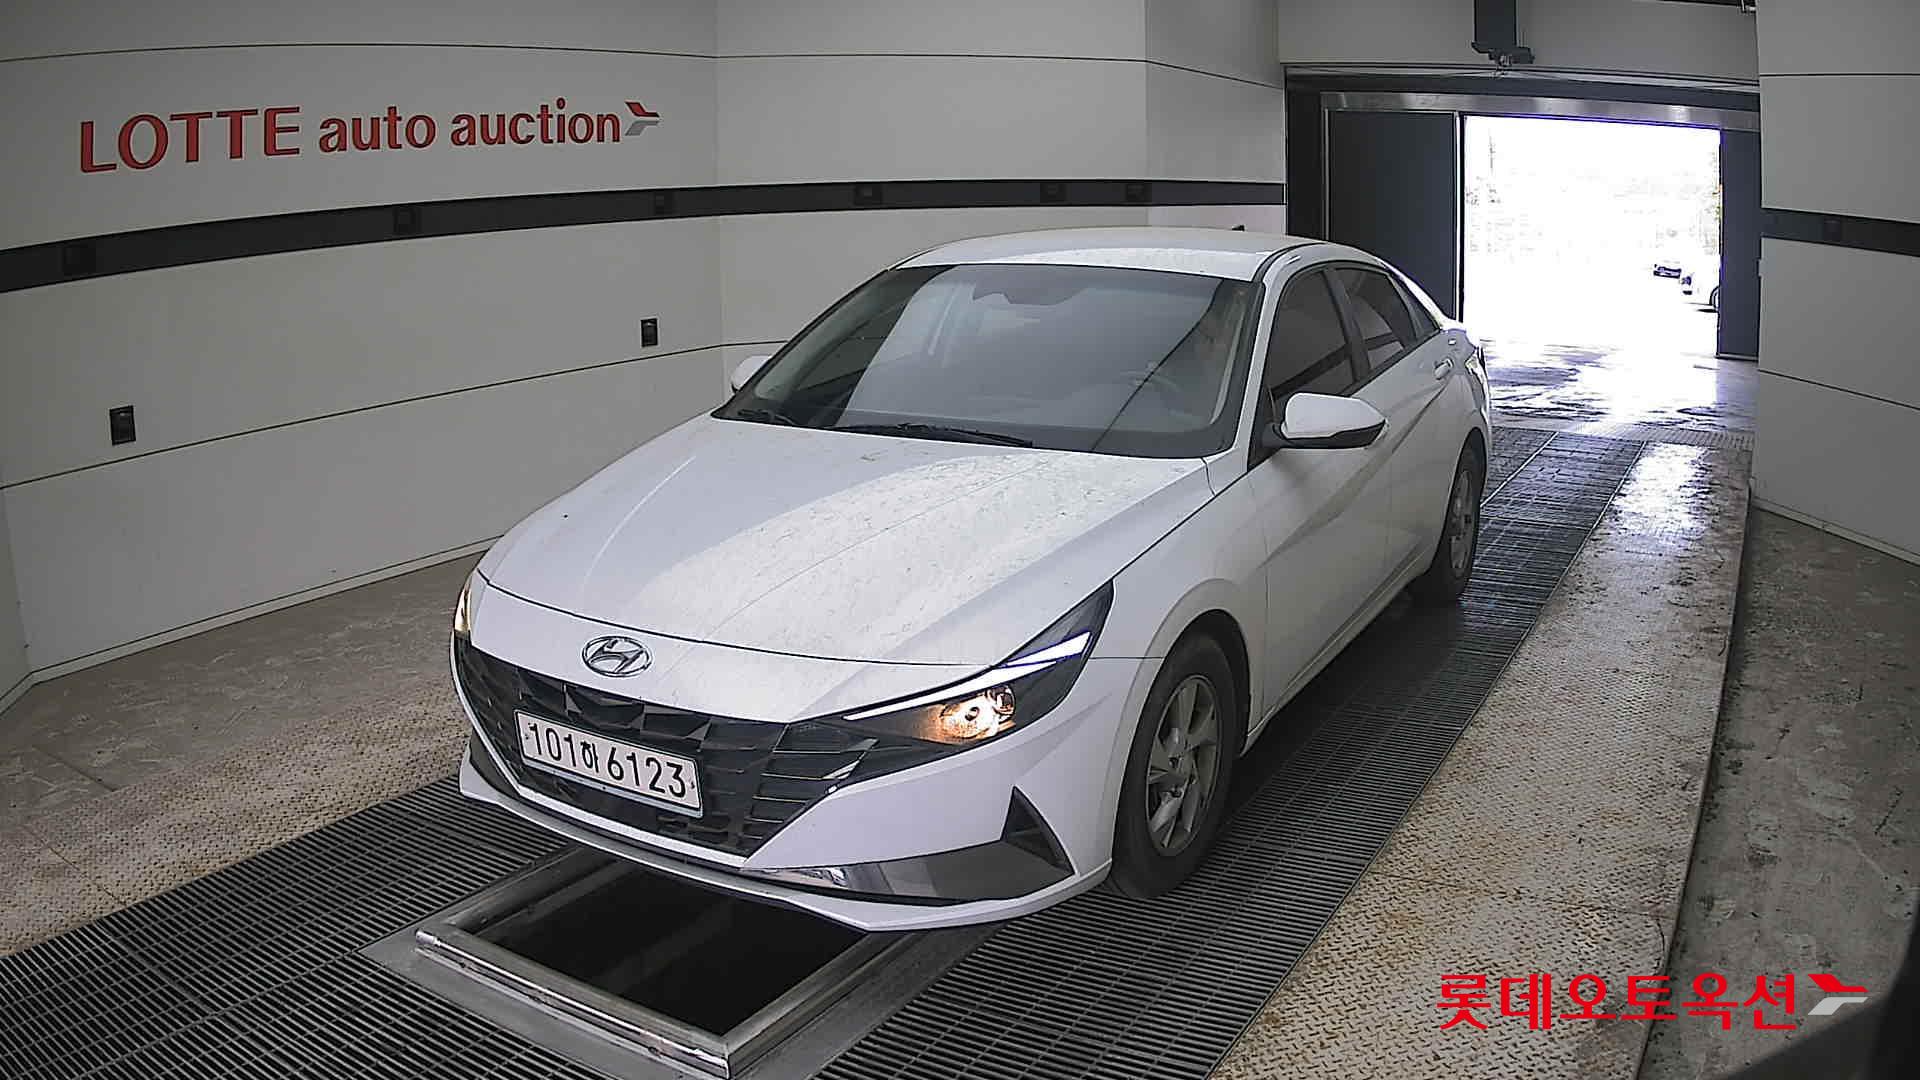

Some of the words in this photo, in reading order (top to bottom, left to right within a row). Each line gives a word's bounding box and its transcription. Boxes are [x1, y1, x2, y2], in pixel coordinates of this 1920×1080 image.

[80, 105, 301, 174] LOTTE
[318, 104, 437, 153] auto
[450, 97, 621, 146] auction
